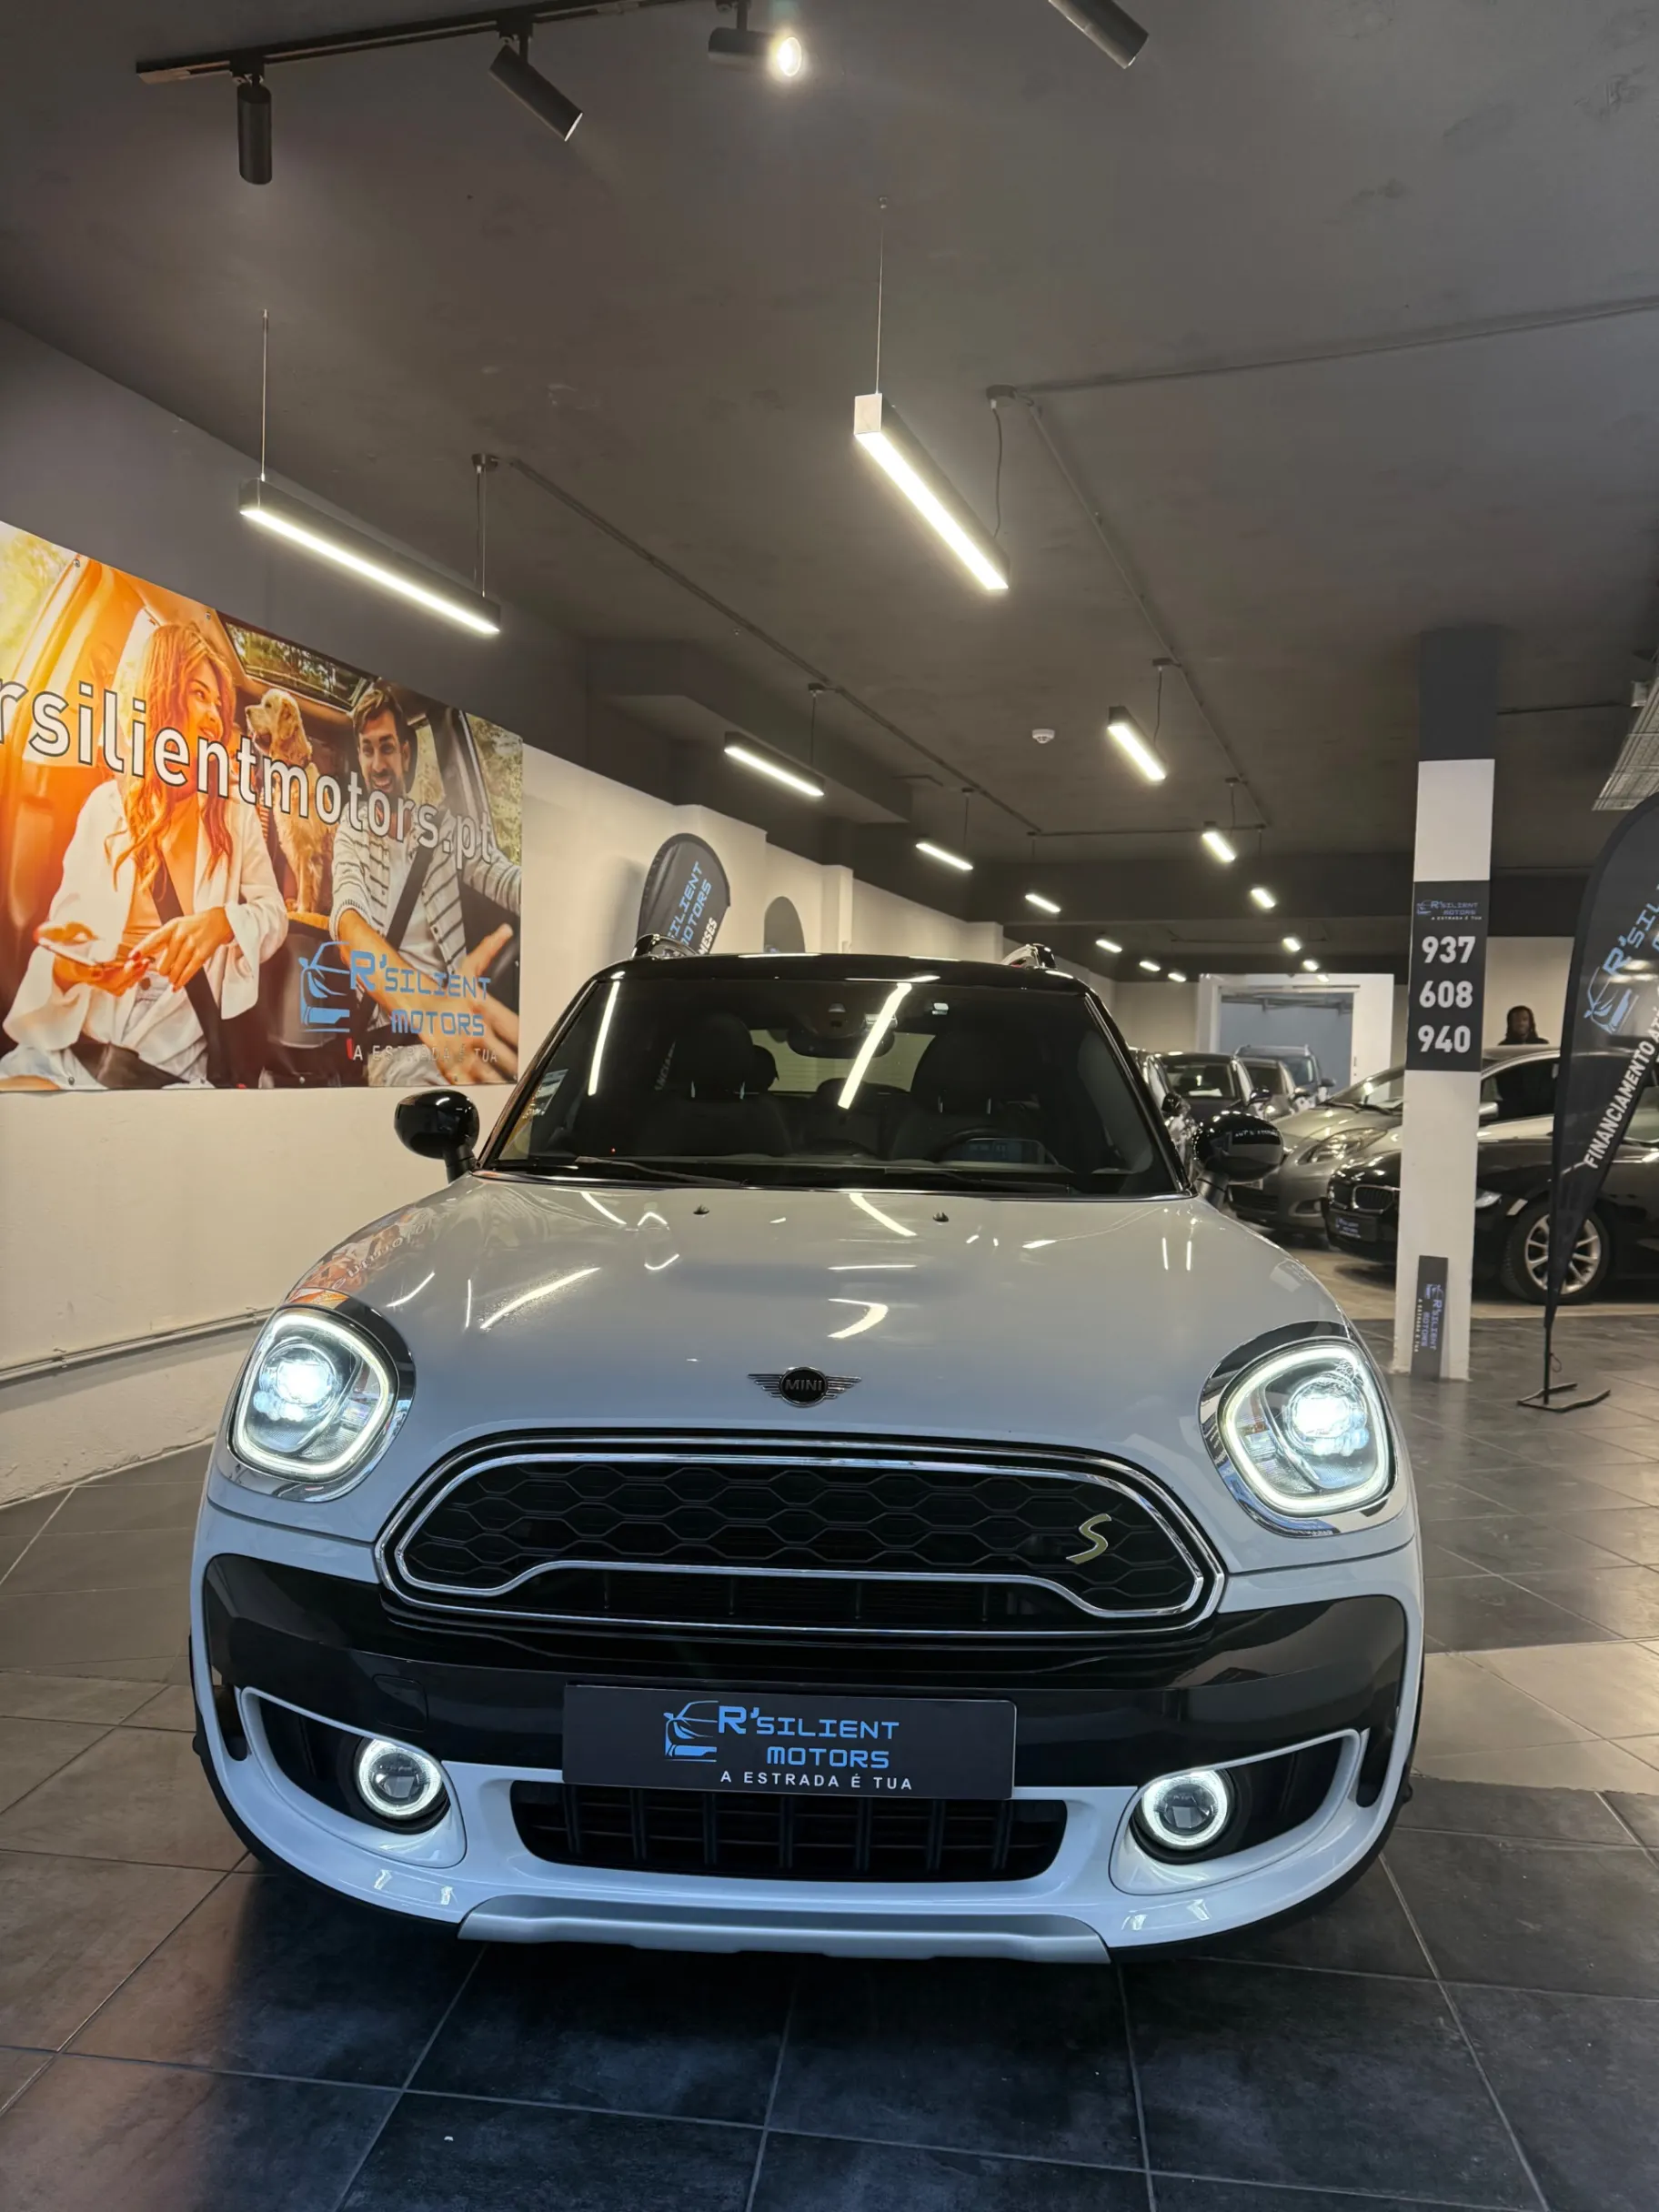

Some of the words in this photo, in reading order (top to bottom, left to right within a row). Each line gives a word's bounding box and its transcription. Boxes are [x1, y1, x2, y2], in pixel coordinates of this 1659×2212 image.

[0, 679, 492, 870] rsilientmotors.pt
[1422, 936, 1475, 963] 937
[350, 950, 491, 999] R'SILIENT
[1419, 980, 1473, 1008] 608
[391, 1010, 484, 1036] MOTORS
[1418, 1025, 1471, 1052] 940
[353, 1044, 363, 1061] A
[474, 1047, 498, 1062] TUA
[1584, 1041, 1655, 1169] FINANCIAMENTO
[785, 1379, 822, 1391] MINI
[718, 1705, 900, 1739] R'SILIENT
[767, 1746, 890, 1769] MOTORS
[720, 1771, 731, 1783] A
[744, 1772, 839, 1787] ESTRADA
[851, 1774, 860, 1788] É
[873, 1777, 912, 1790] TUA
